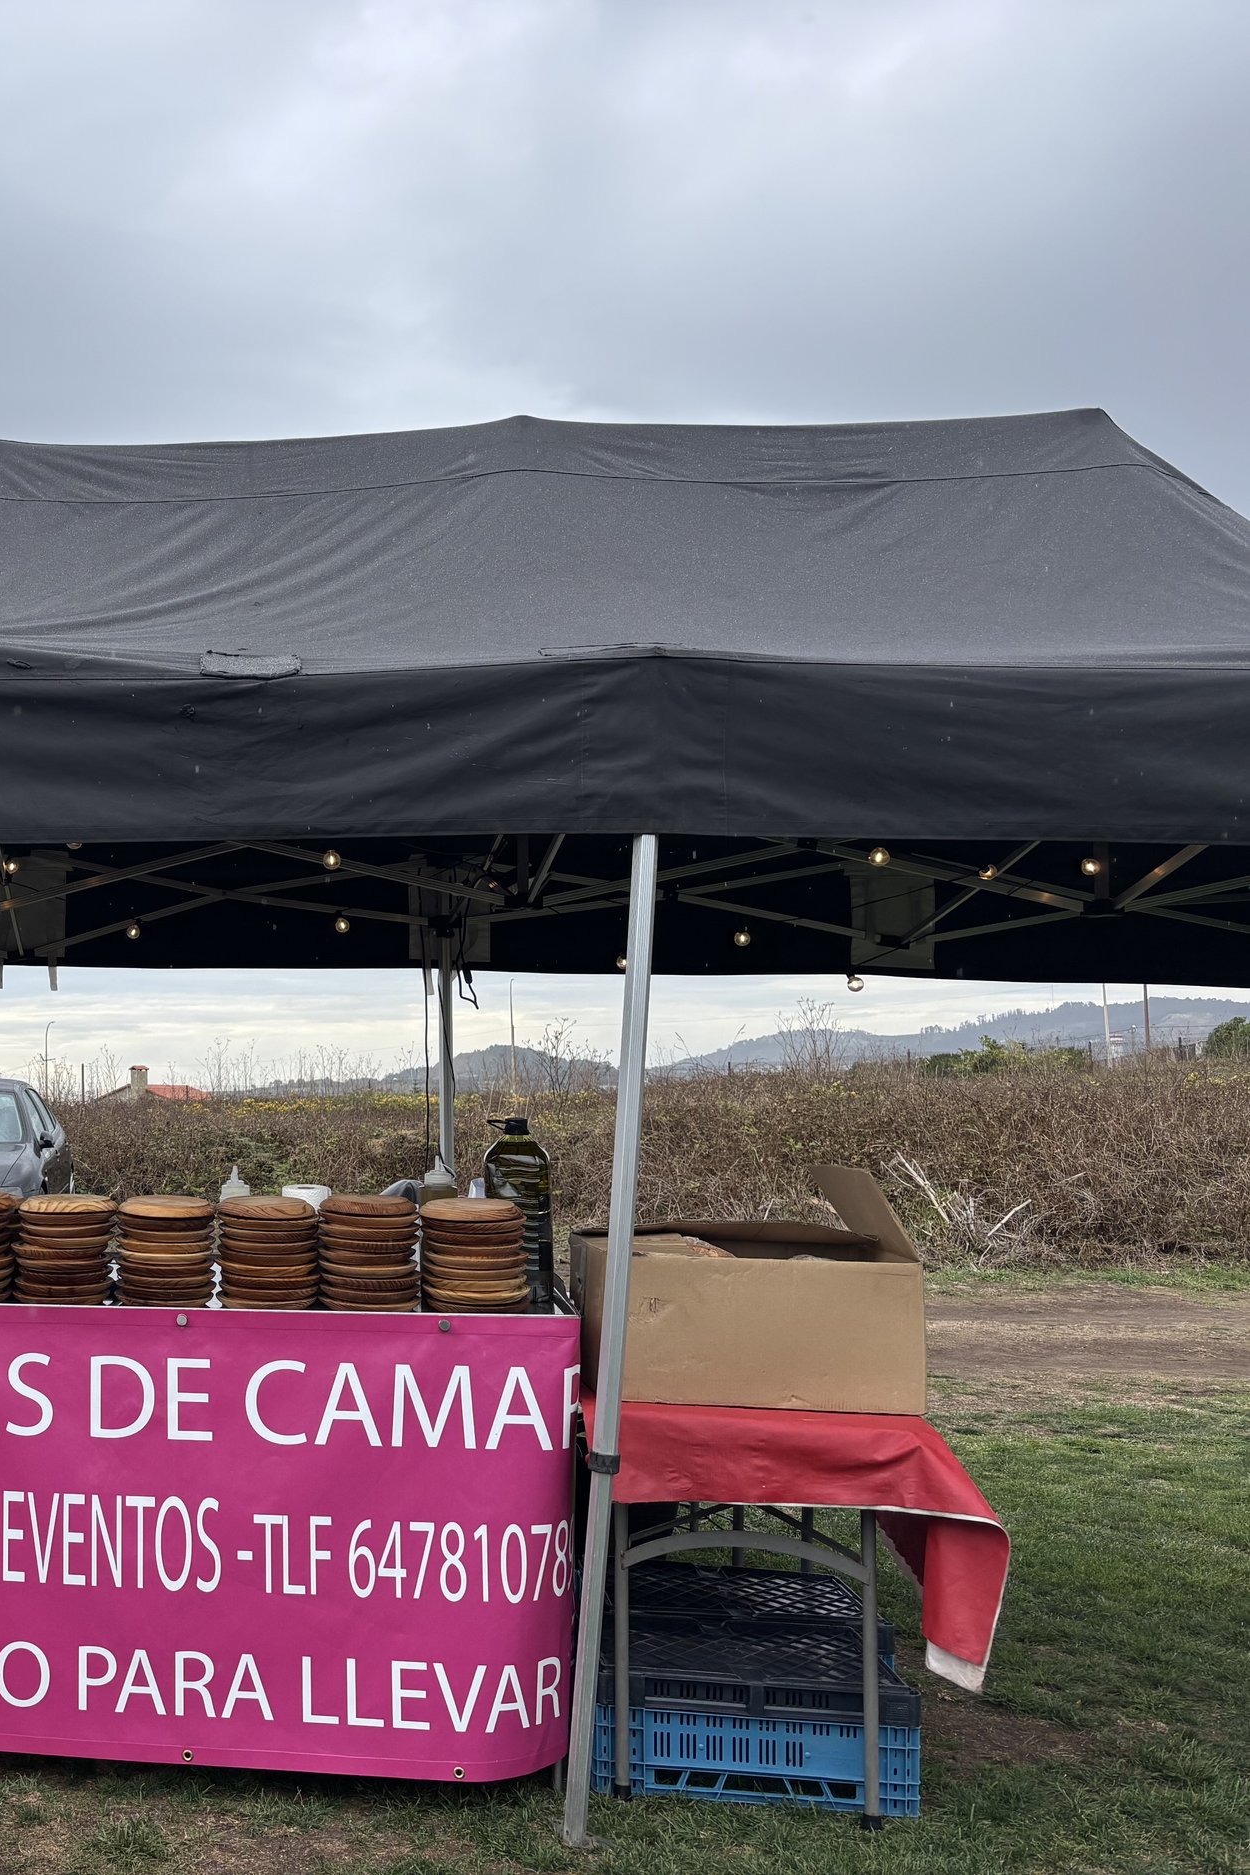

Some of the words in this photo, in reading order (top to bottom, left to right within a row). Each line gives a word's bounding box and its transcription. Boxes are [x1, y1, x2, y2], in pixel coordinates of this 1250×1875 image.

[90, 1356, 213, 1442] DE
[3, 1491, 222, 1593] EVENTOS
[79, 1646, 274, 1721] PARA
[302, 1656, 561, 1734] LLEVAR
